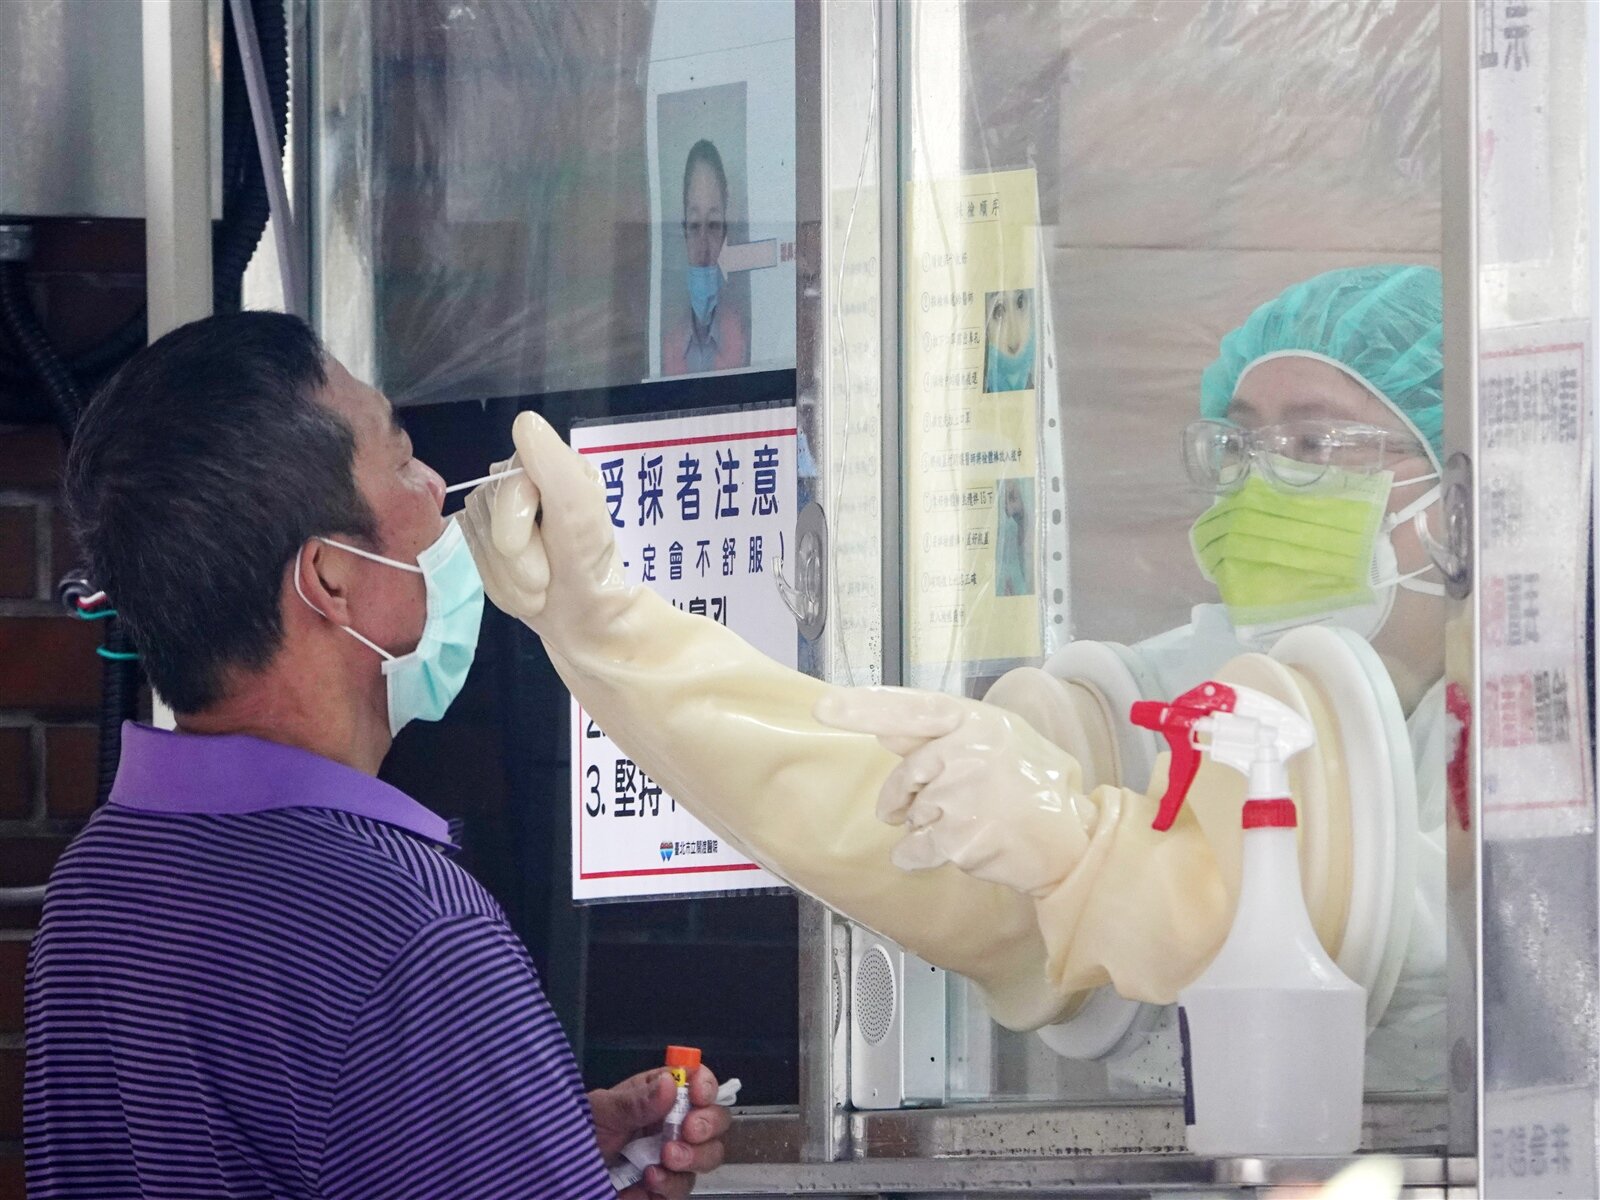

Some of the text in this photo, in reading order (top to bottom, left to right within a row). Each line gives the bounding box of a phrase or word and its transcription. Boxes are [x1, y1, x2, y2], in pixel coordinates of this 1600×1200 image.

[601, 444, 779, 528] 受採者注意
